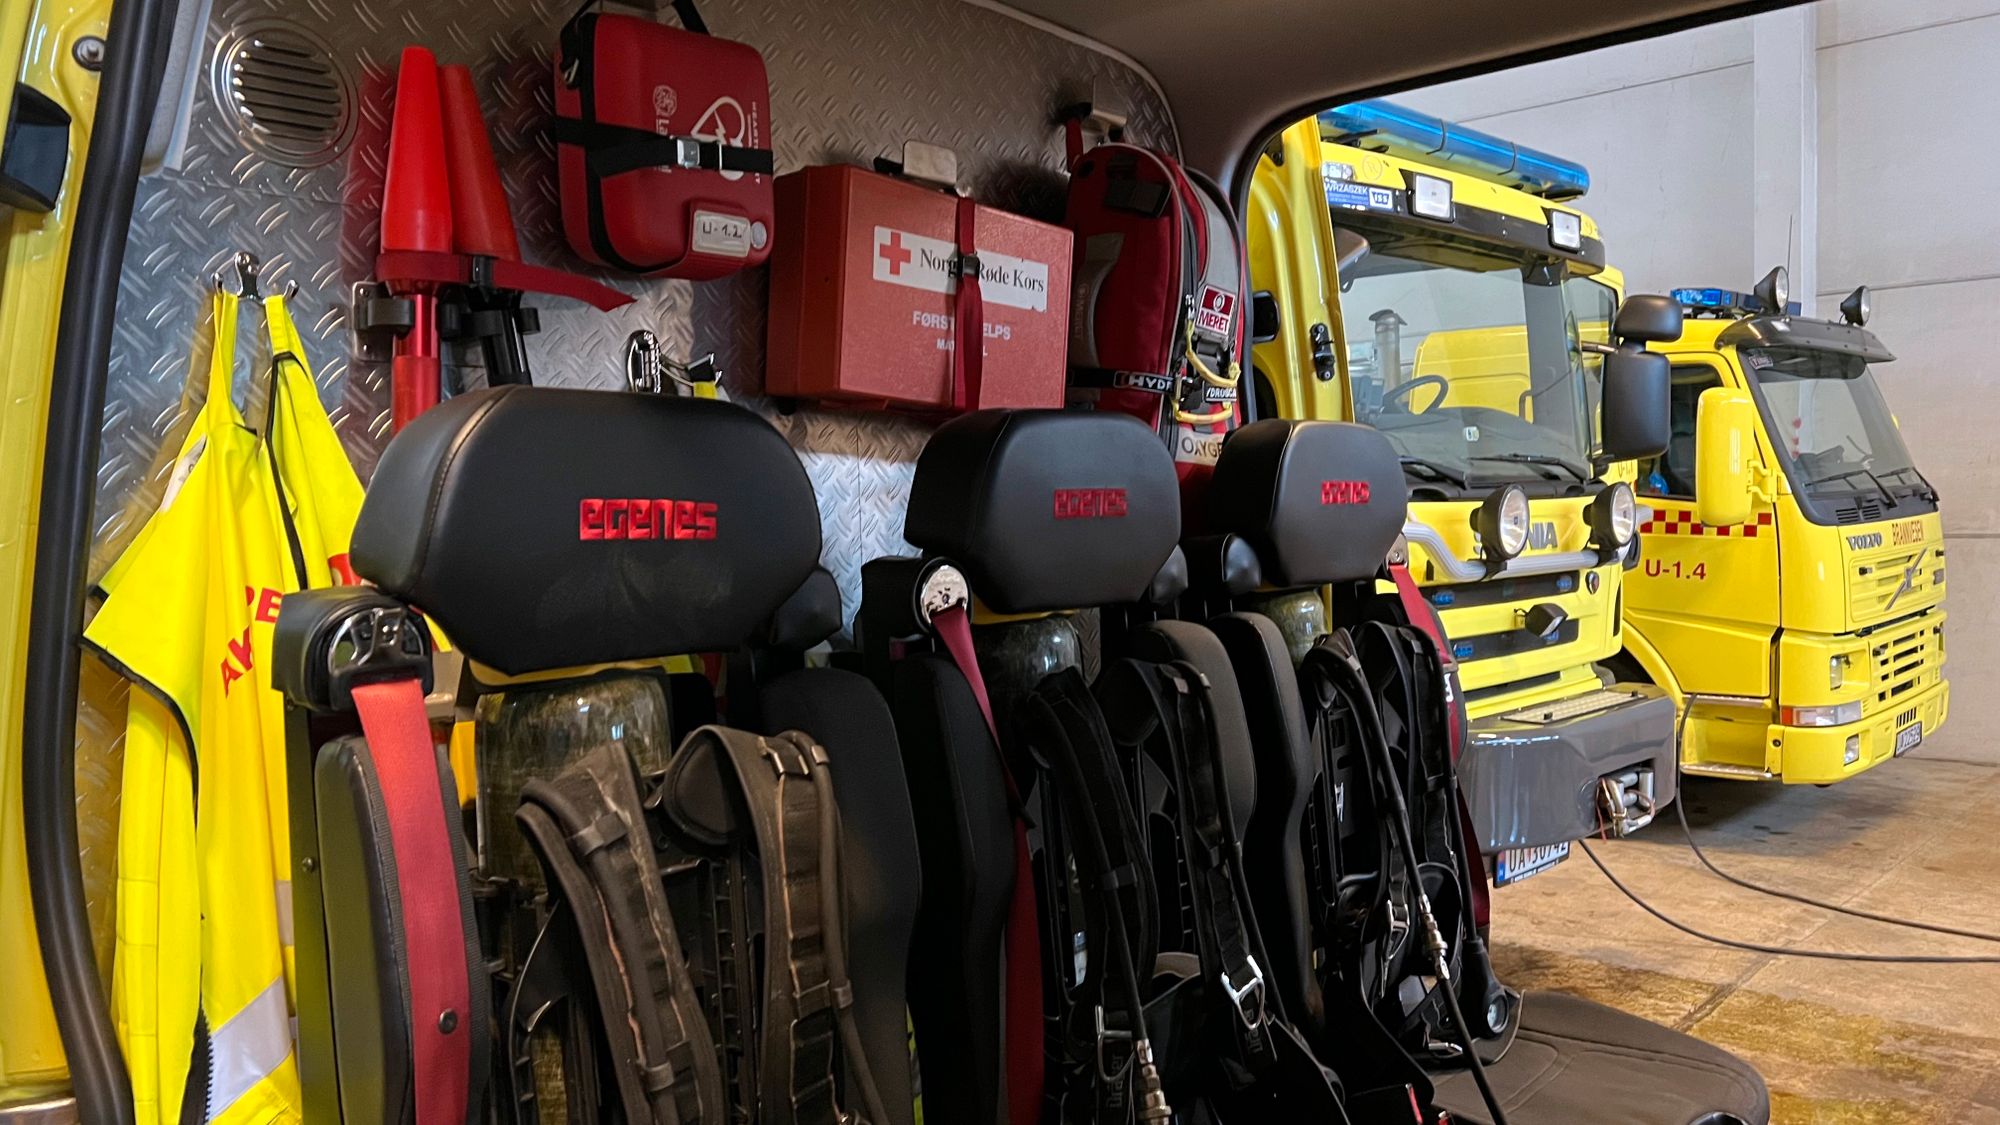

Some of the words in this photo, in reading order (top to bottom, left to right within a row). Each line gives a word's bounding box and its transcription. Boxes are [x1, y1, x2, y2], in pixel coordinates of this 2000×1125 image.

[1013, 269, 1044, 292] Kors
[1199, 310, 1229, 331] MERET
[1182, 436, 1222, 458] OXYGE
[1846, 533, 1882, 551] VOLVO
[1645, 559, 1707, 580] U-1.4
